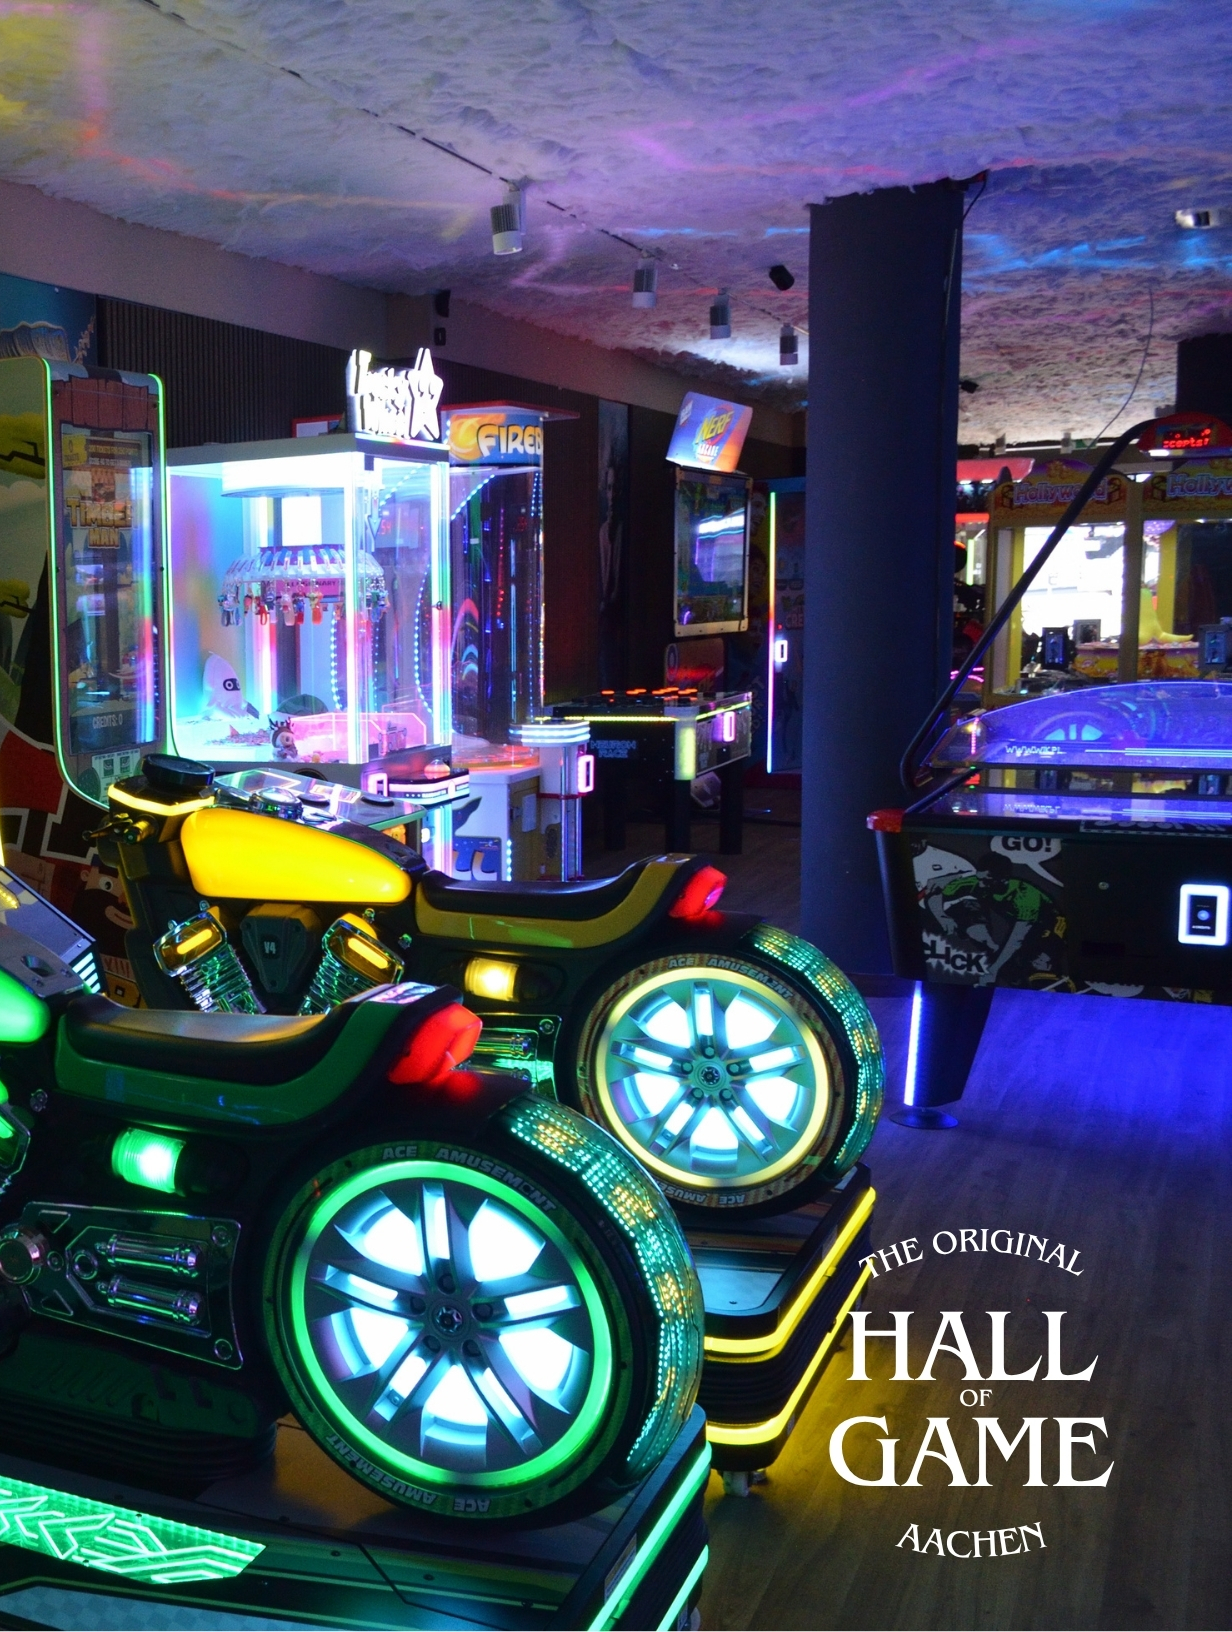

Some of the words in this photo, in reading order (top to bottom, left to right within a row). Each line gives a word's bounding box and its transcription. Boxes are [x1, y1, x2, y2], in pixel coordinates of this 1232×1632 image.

[695, 410, 735, 444] NERF
[1013, 478, 1108, 504] Hollywd
[88, 528, 120, 548] MAN
[93, 714, 117, 729] CREDITS:
[1001, 836, 1052, 852] GO!
[669, 957, 695, 969] ACE
[382, 1145, 418, 1161] ACE
[719, 1194, 745, 1205] ACE
[325, 1433, 438, 1505] AMUSEMENT
[453, 1498, 491, 1512] ACE
